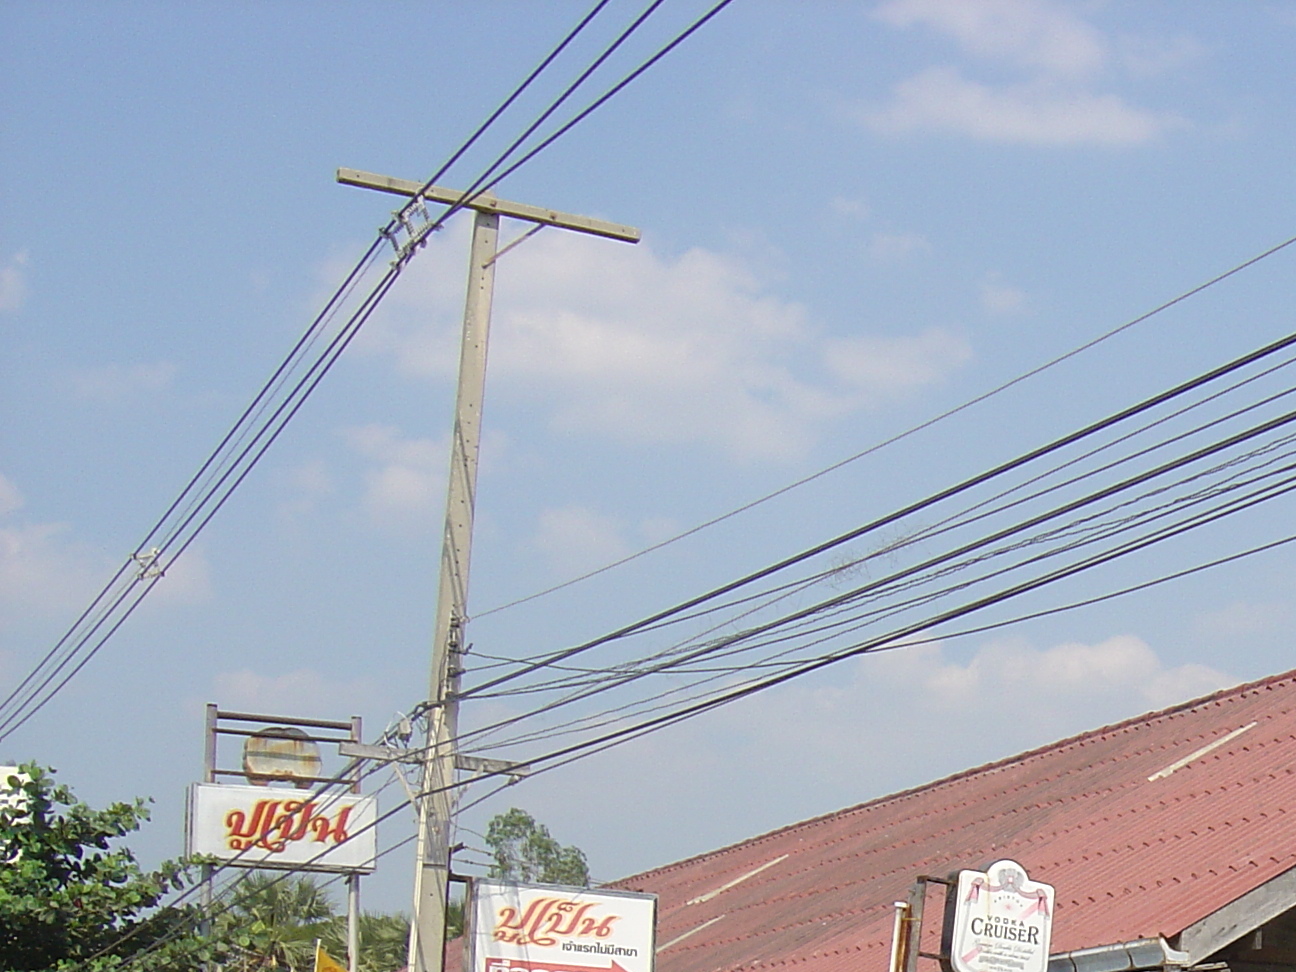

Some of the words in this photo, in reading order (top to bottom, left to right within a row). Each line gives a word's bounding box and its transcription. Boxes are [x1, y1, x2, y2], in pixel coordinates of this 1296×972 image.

[494, 897, 621, 946] ปูเป็น
[971, 917, 1040, 945] CRUISER
[987, 915, 1025, 927] VODKA
[562, 940, 638, 957] เจ้าแรกไม่มีสาขา
